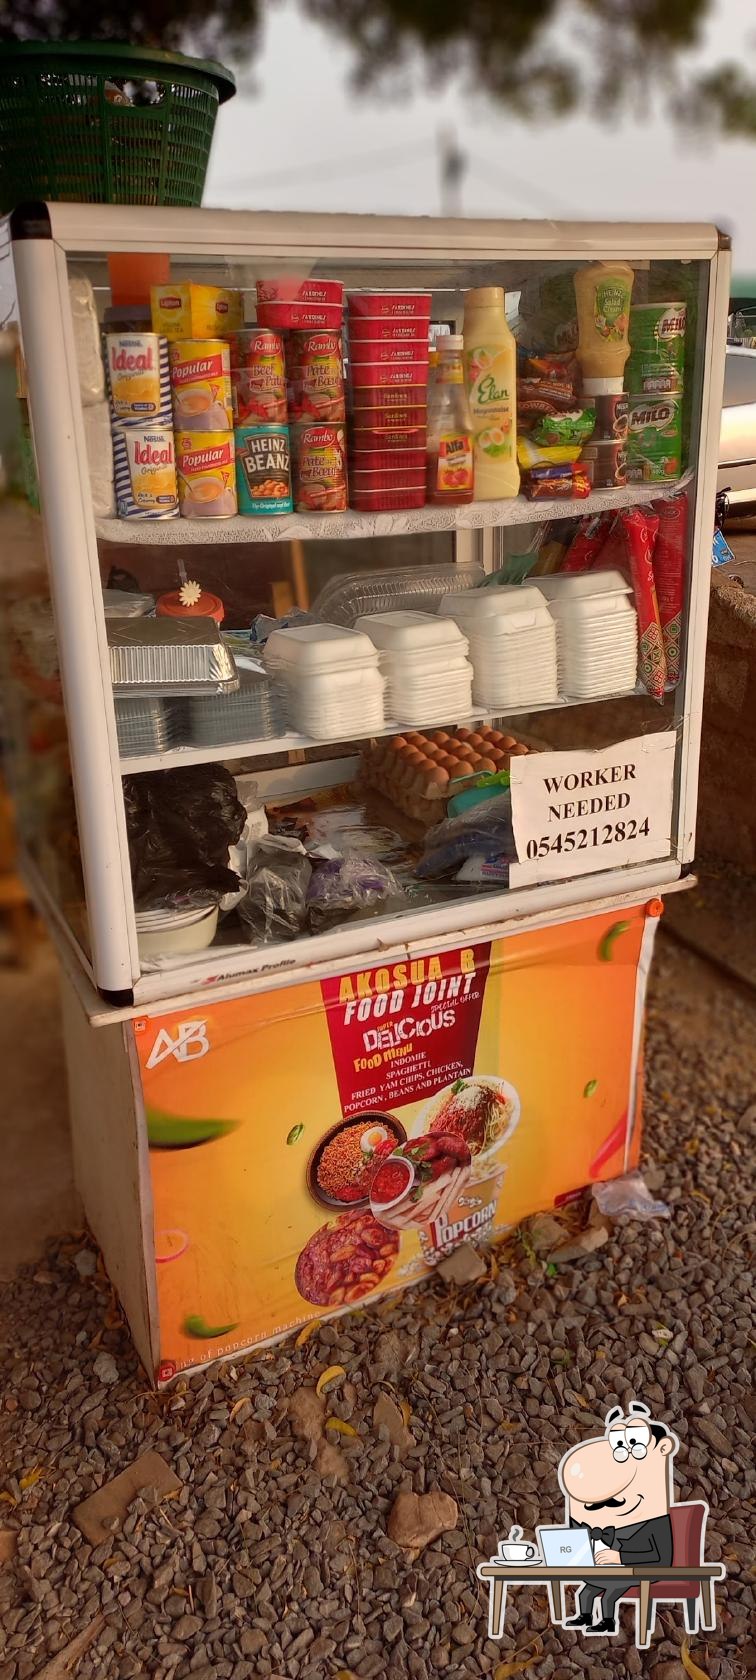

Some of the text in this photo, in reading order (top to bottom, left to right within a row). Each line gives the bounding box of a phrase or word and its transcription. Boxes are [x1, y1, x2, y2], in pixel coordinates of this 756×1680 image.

[111, 346, 154, 371] Ideal
[172, 360, 213, 379] Popular
[631, 406, 671, 426] MILO
[251, 438, 285, 453] HEINZ
[303, 429, 333, 443] Rambo
[446, 439, 464, 454] Alfa
[134, 441, 173, 465] Ideal
[182, 448, 224, 468] Popular
[244, 453, 289, 474] BEANZ
[543, 763, 637, 794] WORKER
[548, 792, 631, 823] NEEDED
[526, 817, 650, 859] 0545212824
[217, 958, 297, 982] Alumax Profile
[339, 956, 443, 1004] AKOSUA
[343, 972, 476, 1026] FOOD JOINT
[385, 1060, 432, 1080] SPAGHETTI
[390, 1051, 427, 1068] INDOMIE
[351, 1061, 464, 1100] FRIED YAM CHIPS, CHICKEN,
[388, 1087, 414, 1099] BEANS
[415, 1080, 432, 1092] AND
[433, 1067, 472, 1086] PLANTAIN
[200, 1311, 321, 1362] of popcorn machine
